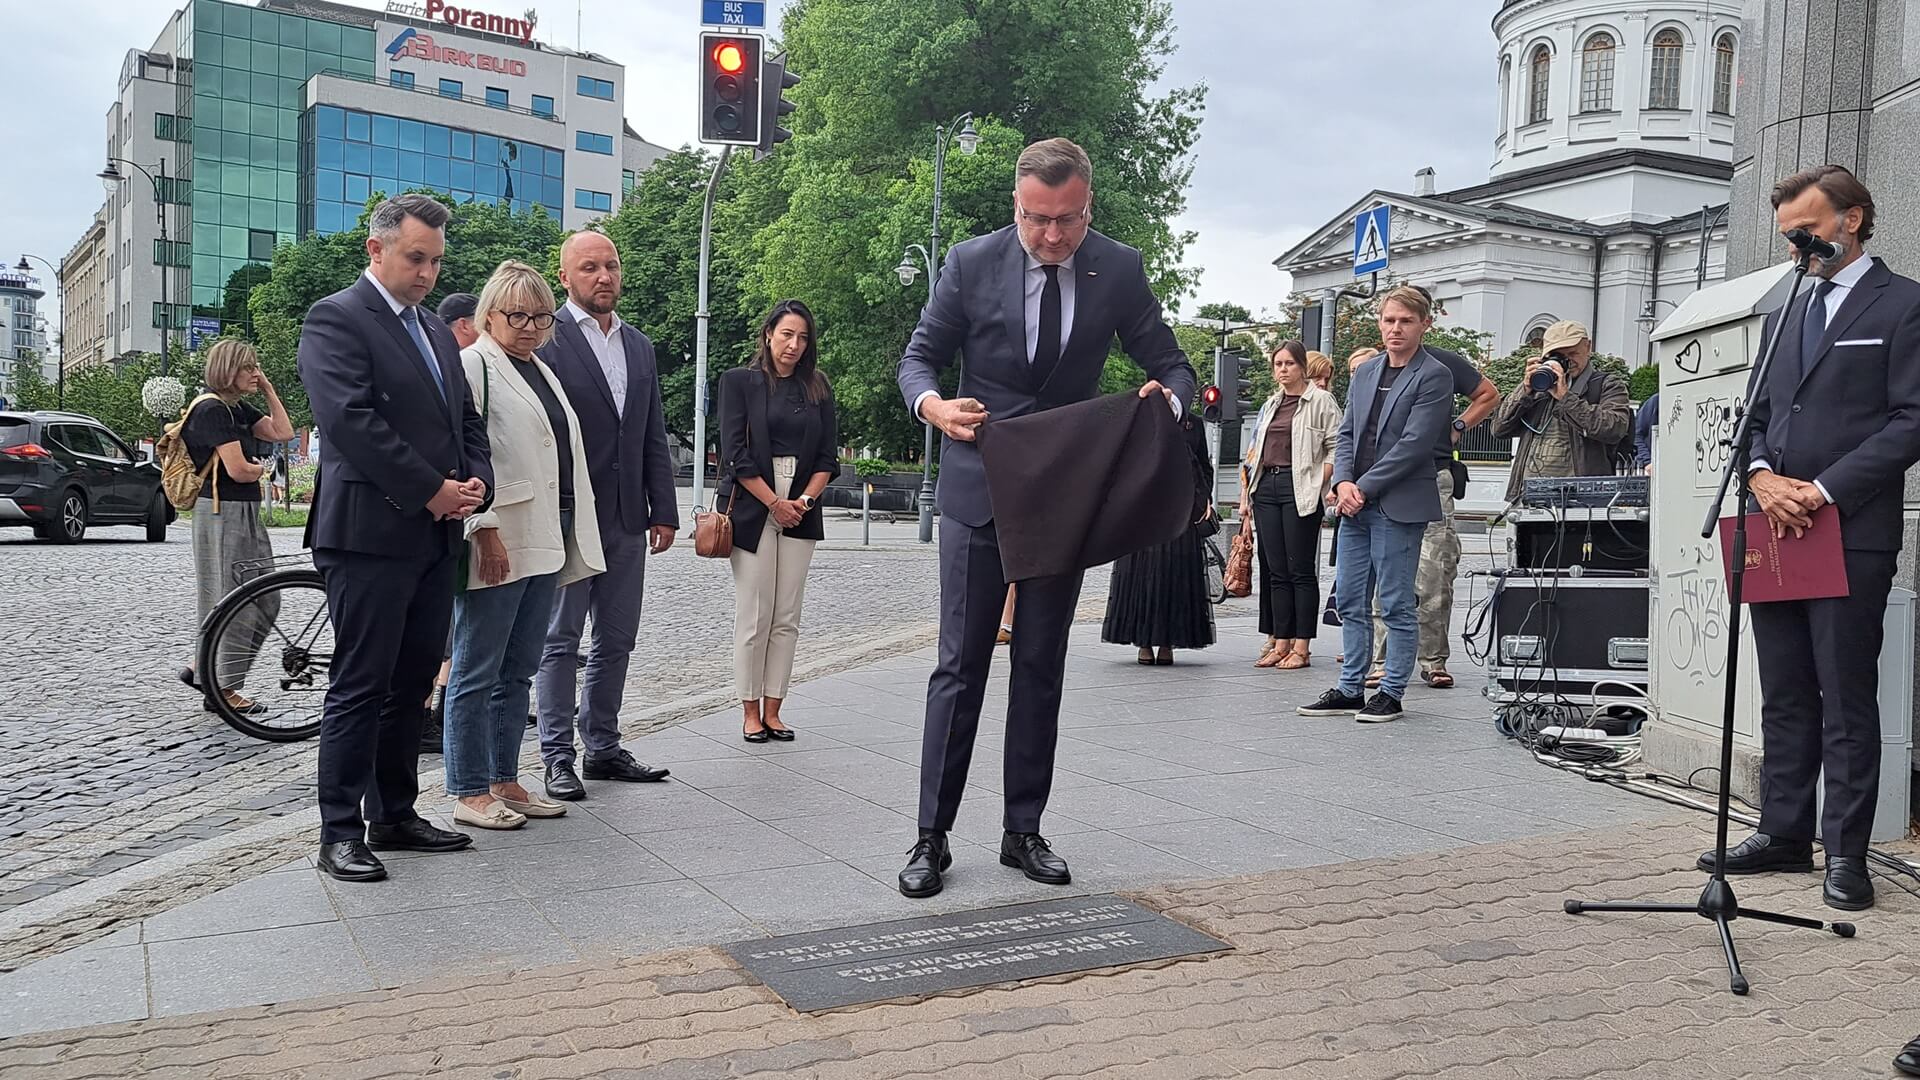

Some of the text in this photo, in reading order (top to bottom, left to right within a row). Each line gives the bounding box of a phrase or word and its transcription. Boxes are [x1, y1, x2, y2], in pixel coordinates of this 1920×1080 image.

[724, 2, 743, 13] BUS
[426, 0, 534, 45] Poranny
[722, 13, 744, 24] TAXI
[1080, 905, 1128, 914] JULY
[788, 913, 1126, 962] HERE WAS THE GHETTO GATE
[1066, 936, 1098, 944] VII
[751, 945, 817, 958] 1943
[910, 957, 951, 966] VIII
[946, 953, 1038, 969] BRAMA
[837, 962, 905, 976] 1943
[859, 967, 941, 982] GETTA
